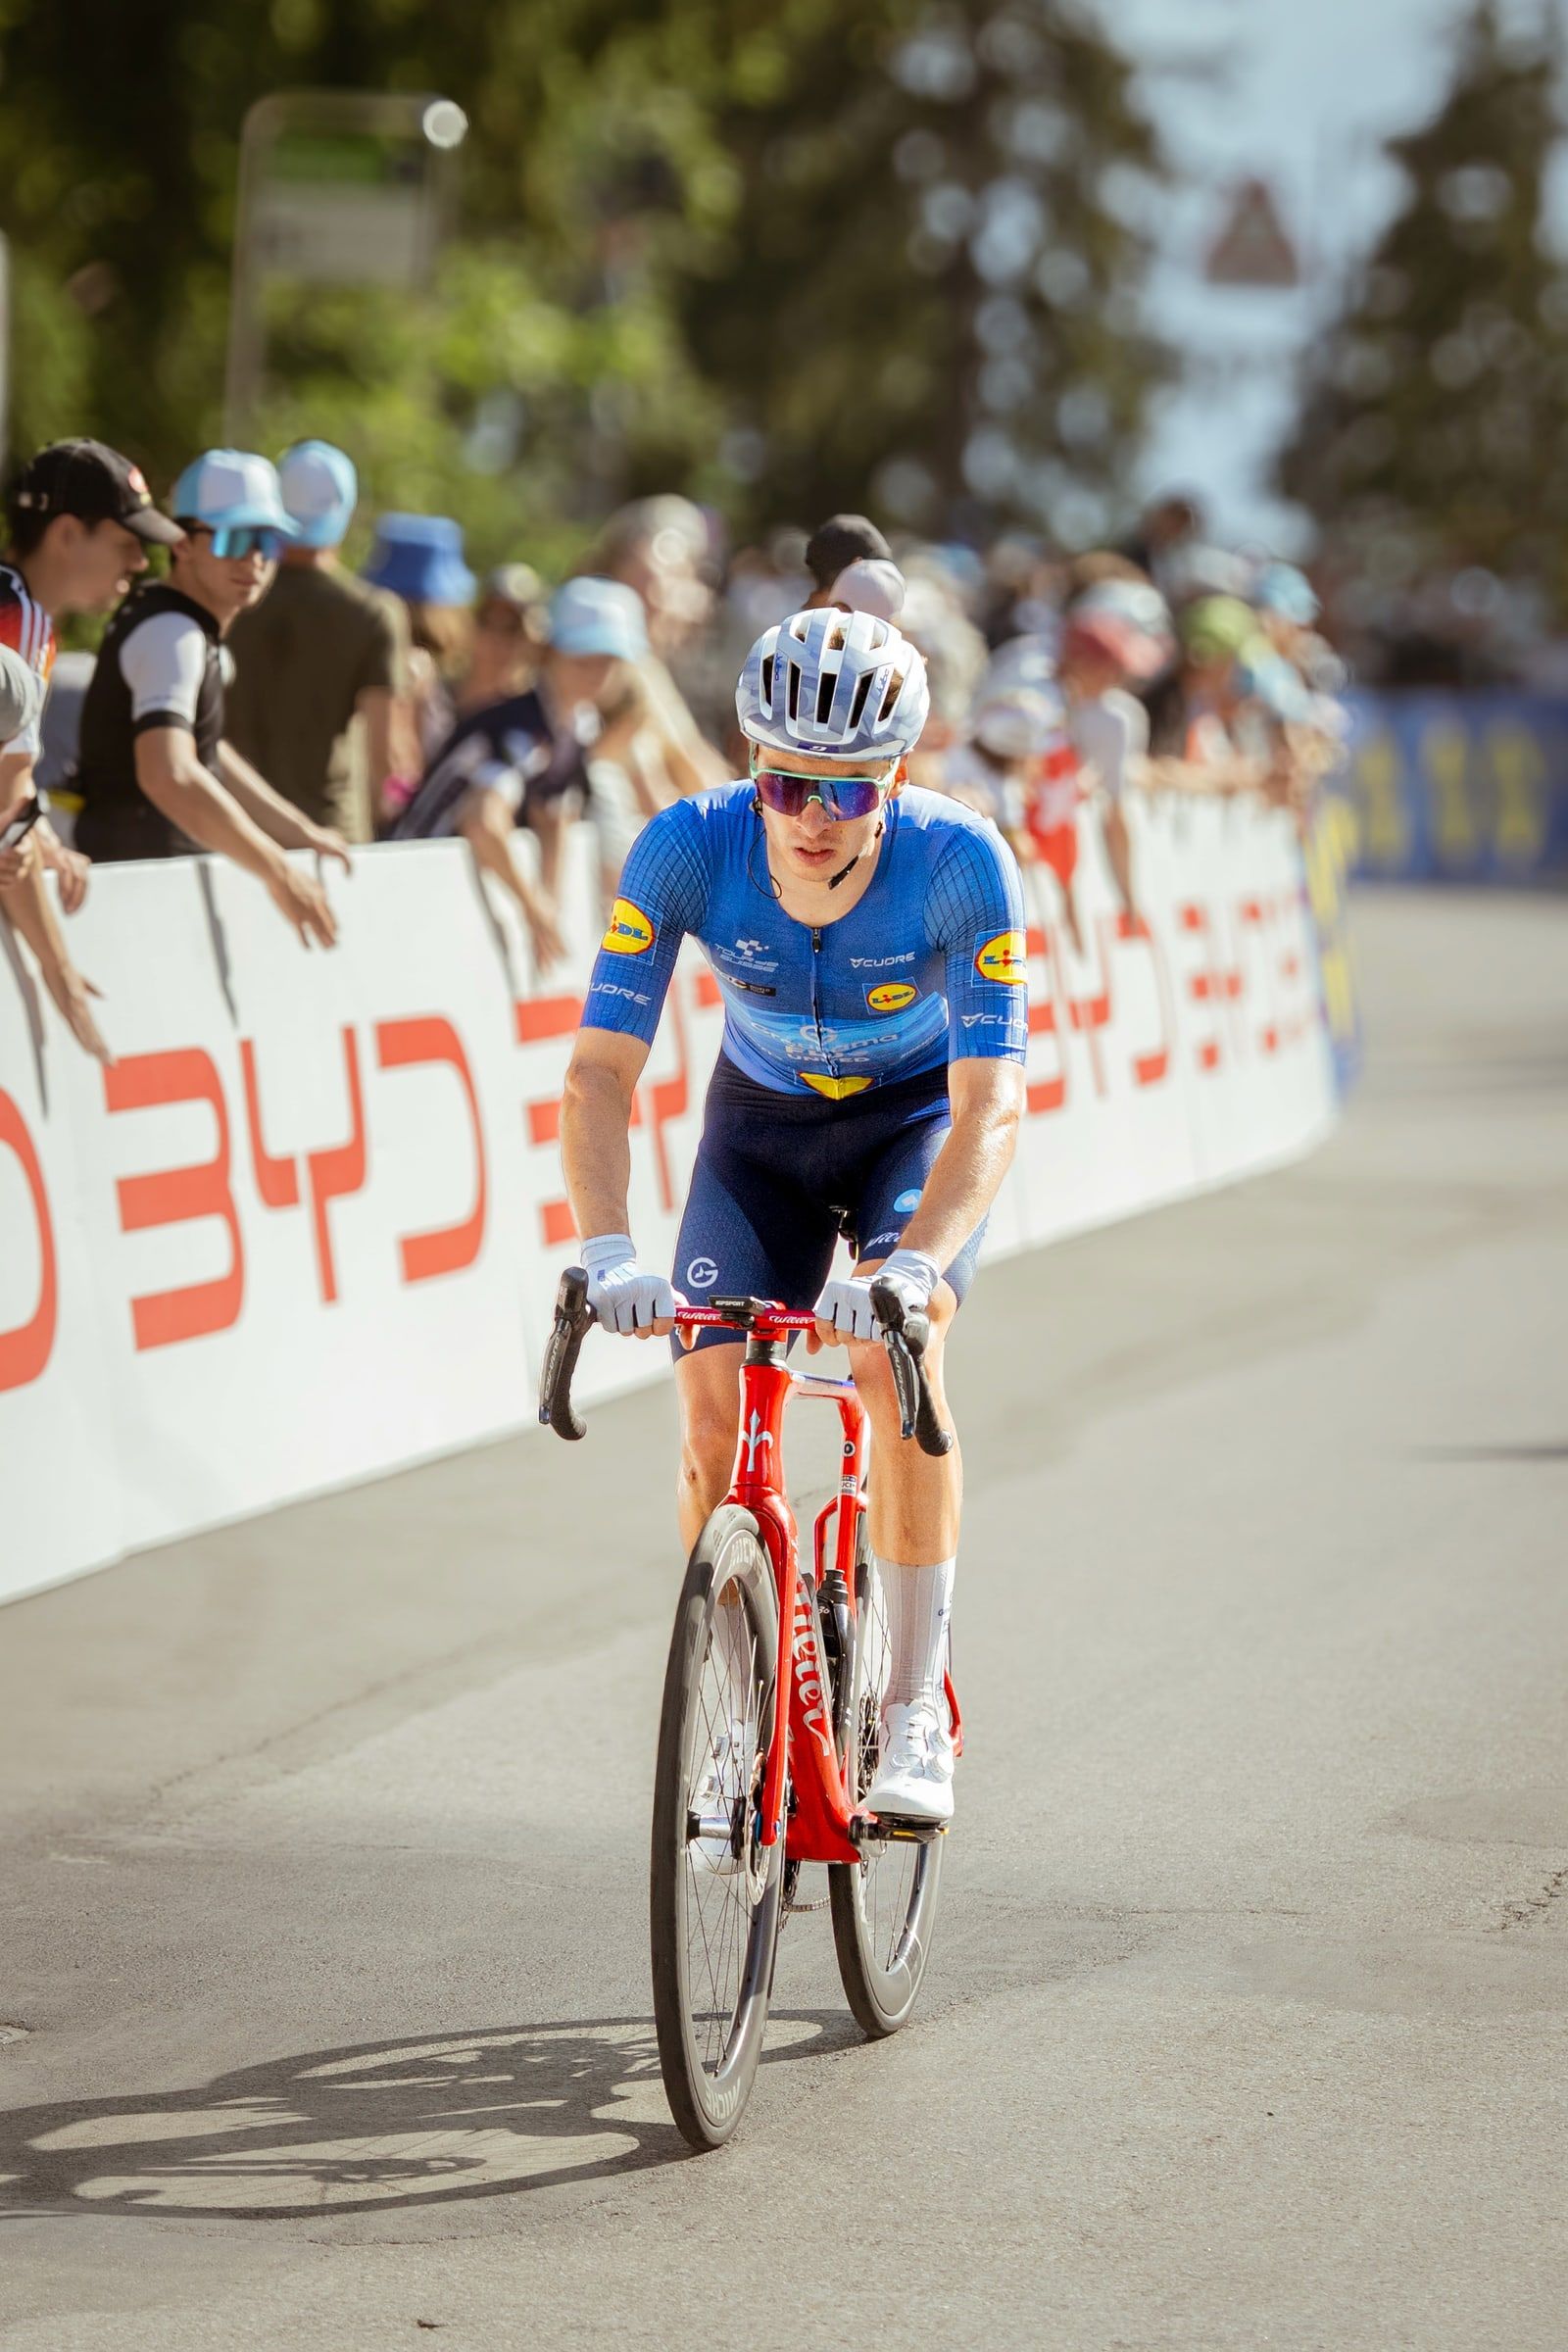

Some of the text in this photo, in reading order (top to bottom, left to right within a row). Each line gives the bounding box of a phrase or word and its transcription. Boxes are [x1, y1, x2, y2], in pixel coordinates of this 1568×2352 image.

[863, 951, 916, 968] CUORE
[590, 982, 652, 1005] UORE
[102, 1015, 487, 1350] BYD
